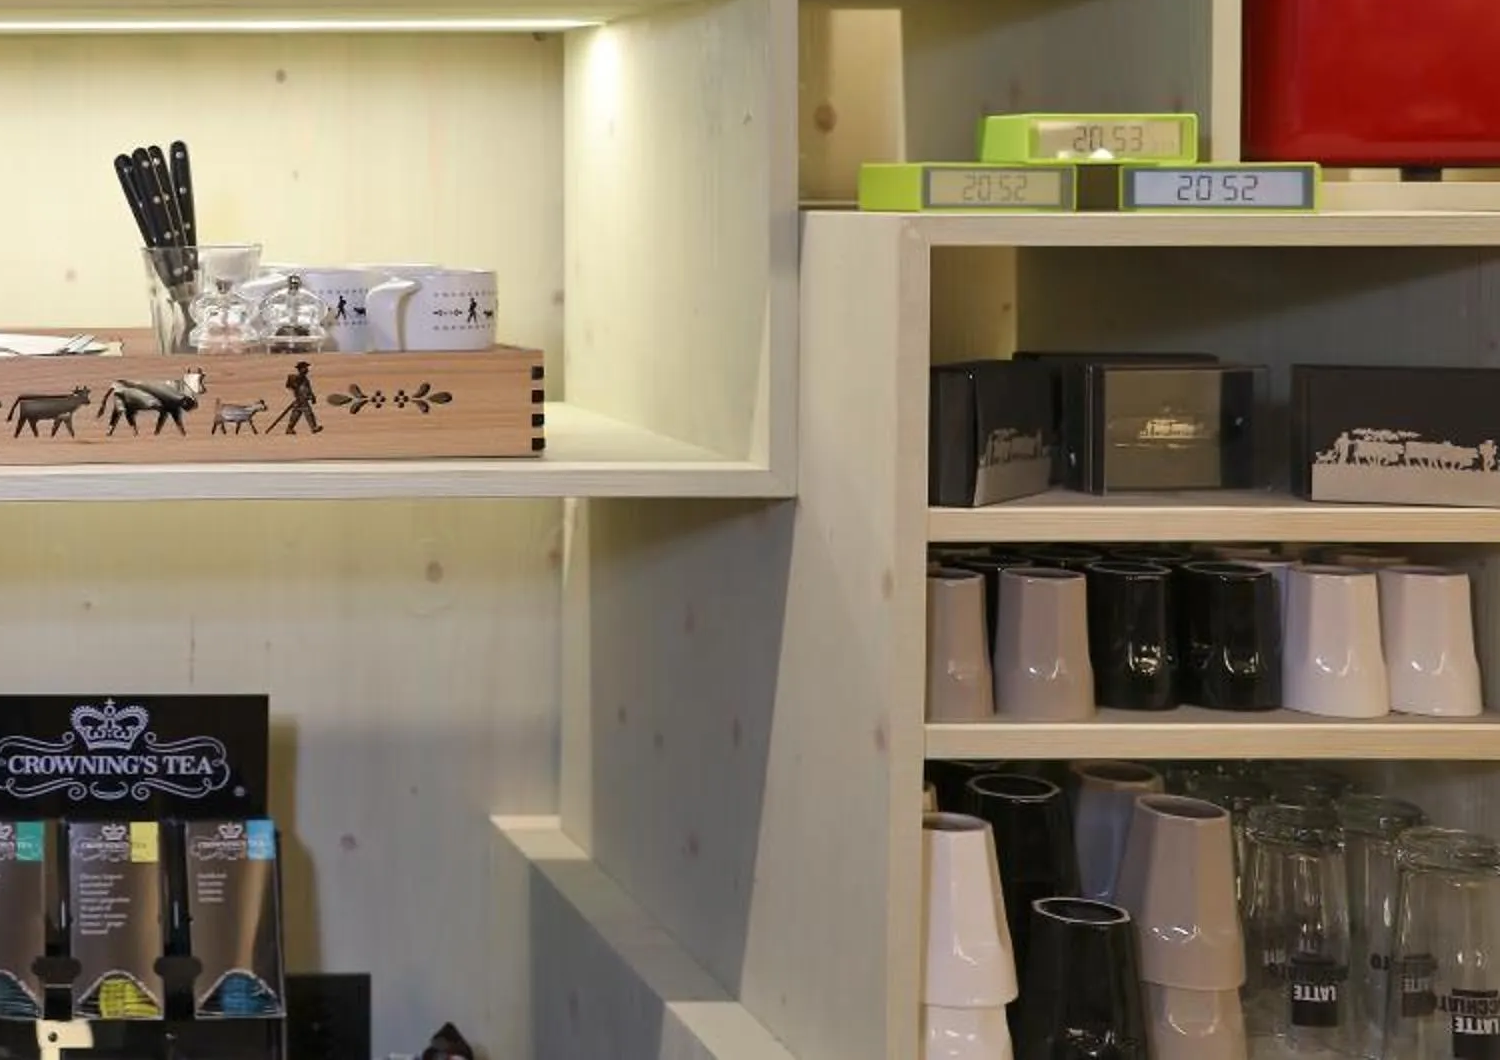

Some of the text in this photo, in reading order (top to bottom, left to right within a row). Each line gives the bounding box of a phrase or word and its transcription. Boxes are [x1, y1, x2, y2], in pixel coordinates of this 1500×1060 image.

[8, 754, 214, 775] CROWNING'S TEA
[1293, 984, 1337, 1002] LATTE
[1454, 1016, 1500, 1034] LATTE
